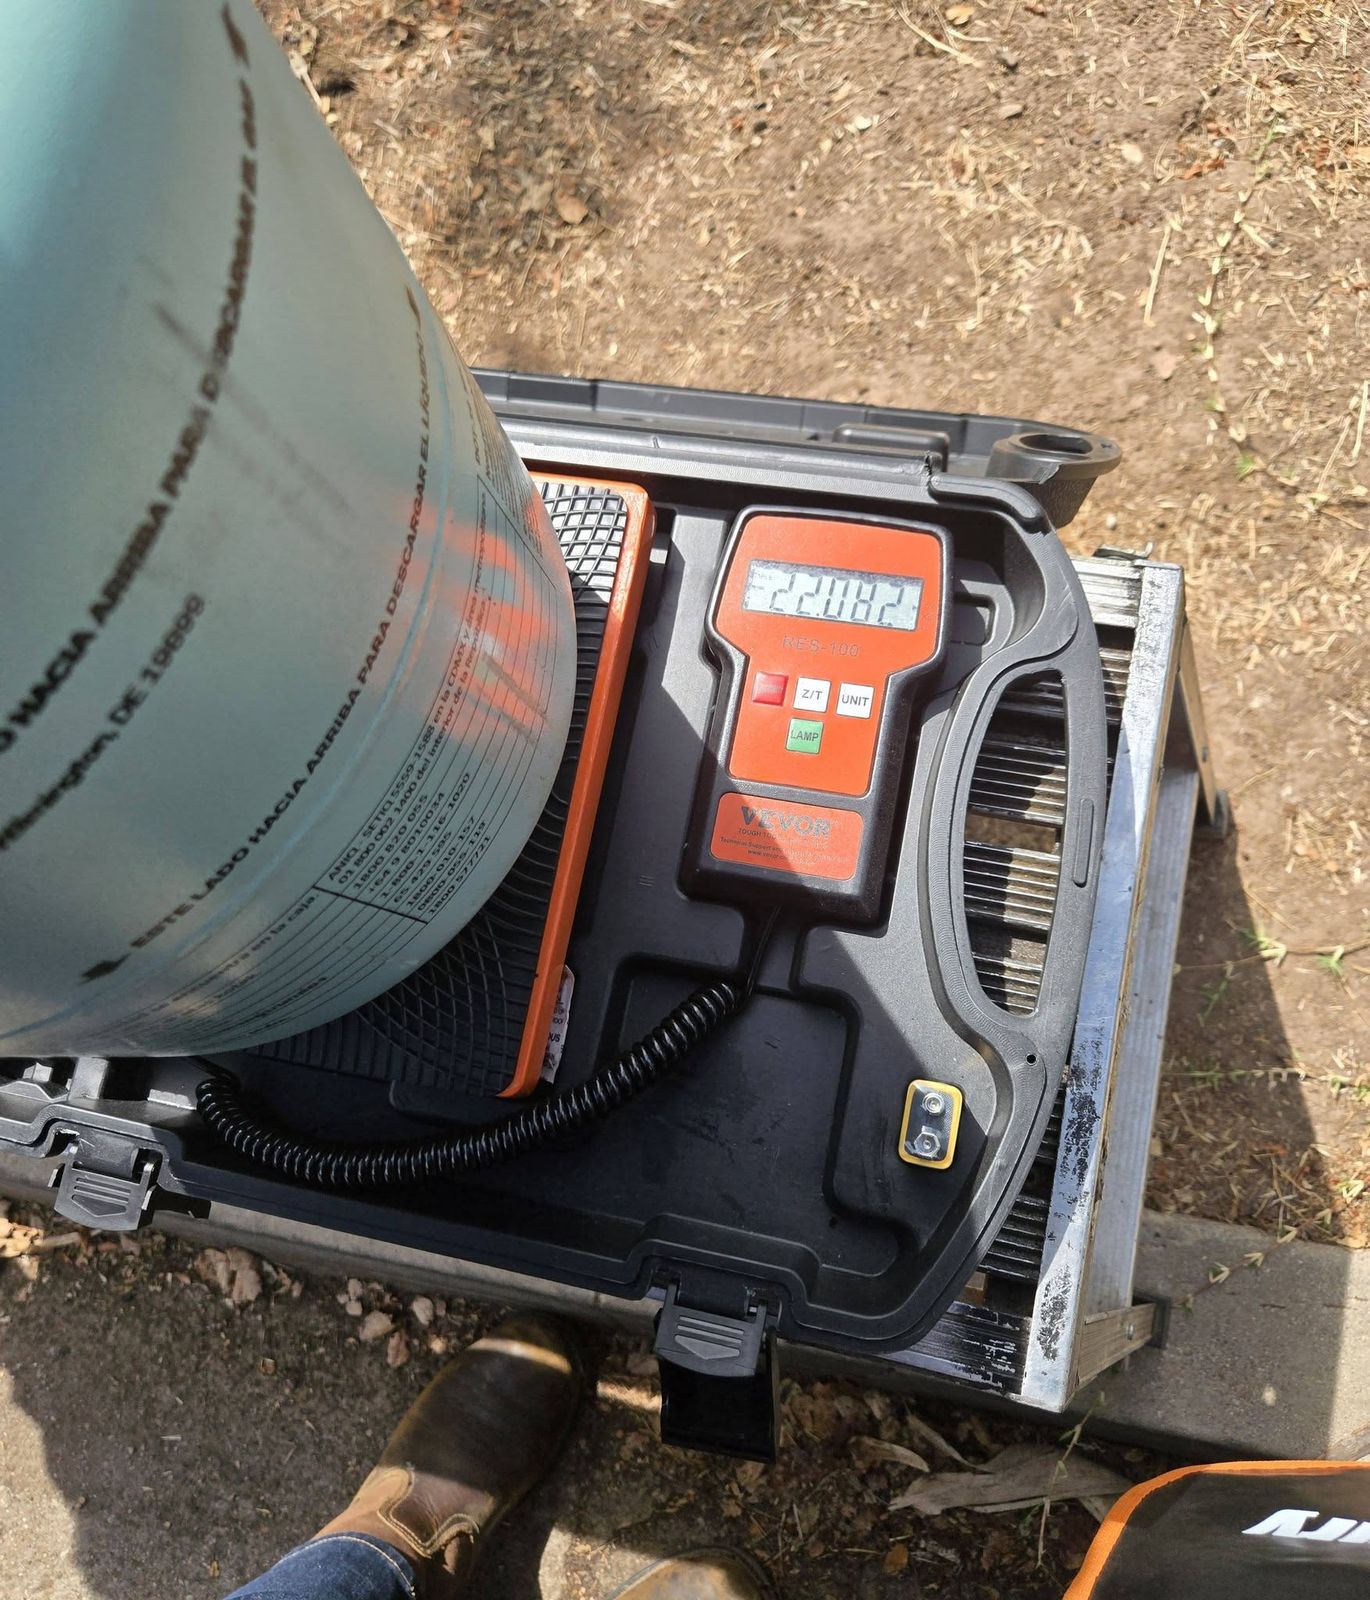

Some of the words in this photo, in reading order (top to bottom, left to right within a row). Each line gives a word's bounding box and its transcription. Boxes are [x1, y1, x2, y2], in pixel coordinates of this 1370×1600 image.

[783, 635, 859, 657] RES-100
[8, 631, 97, 728] HACIA
[129, 903, 195, 948] ESTE
[190, 847, 250, 901] LADO
[248, 778, 308, 844] HACIA
[306, 688, 361, 775] ARRIBA
[357, 622, 391, 684] PARA
[386, 463, 427, 616] DESCARGAR
[420, 433, 430, 463] EL
[801, 688, 823, 701] Z/T
[842, 694, 870, 707] UNIT
[109, 683, 150, 725] DE
[362, 799, 395, 838] SETIQ
[391, 725, 435, 798] 5559-1588
[433, 705, 444, 723] en
[442, 689, 450, 703] la
[448, 642, 467, 687] CDMX
[463, 630, 471, 641] y
[790, 729, 819, 742] LAMP
[338, 869, 354, 884] 01
[354, 842, 376, 867] 800
[374, 817, 395, 842] 002
[394, 782, 418, 815] 1400
[416, 757, 431, 781] del
[430, 708, 455, 757] interior
[453, 686, 463, 705] de
[460, 671, 469, 685] la
[353, 855, 385, 890] 1800
[385, 825, 408, 853] 820
[407, 794, 428, 823] 055
[391, 856, 401, 867] 9
[401, 792, 445, 855] 8010034
[741, 806, 831, 838] VEVOR
[427, 884, 455, 915] 1800
